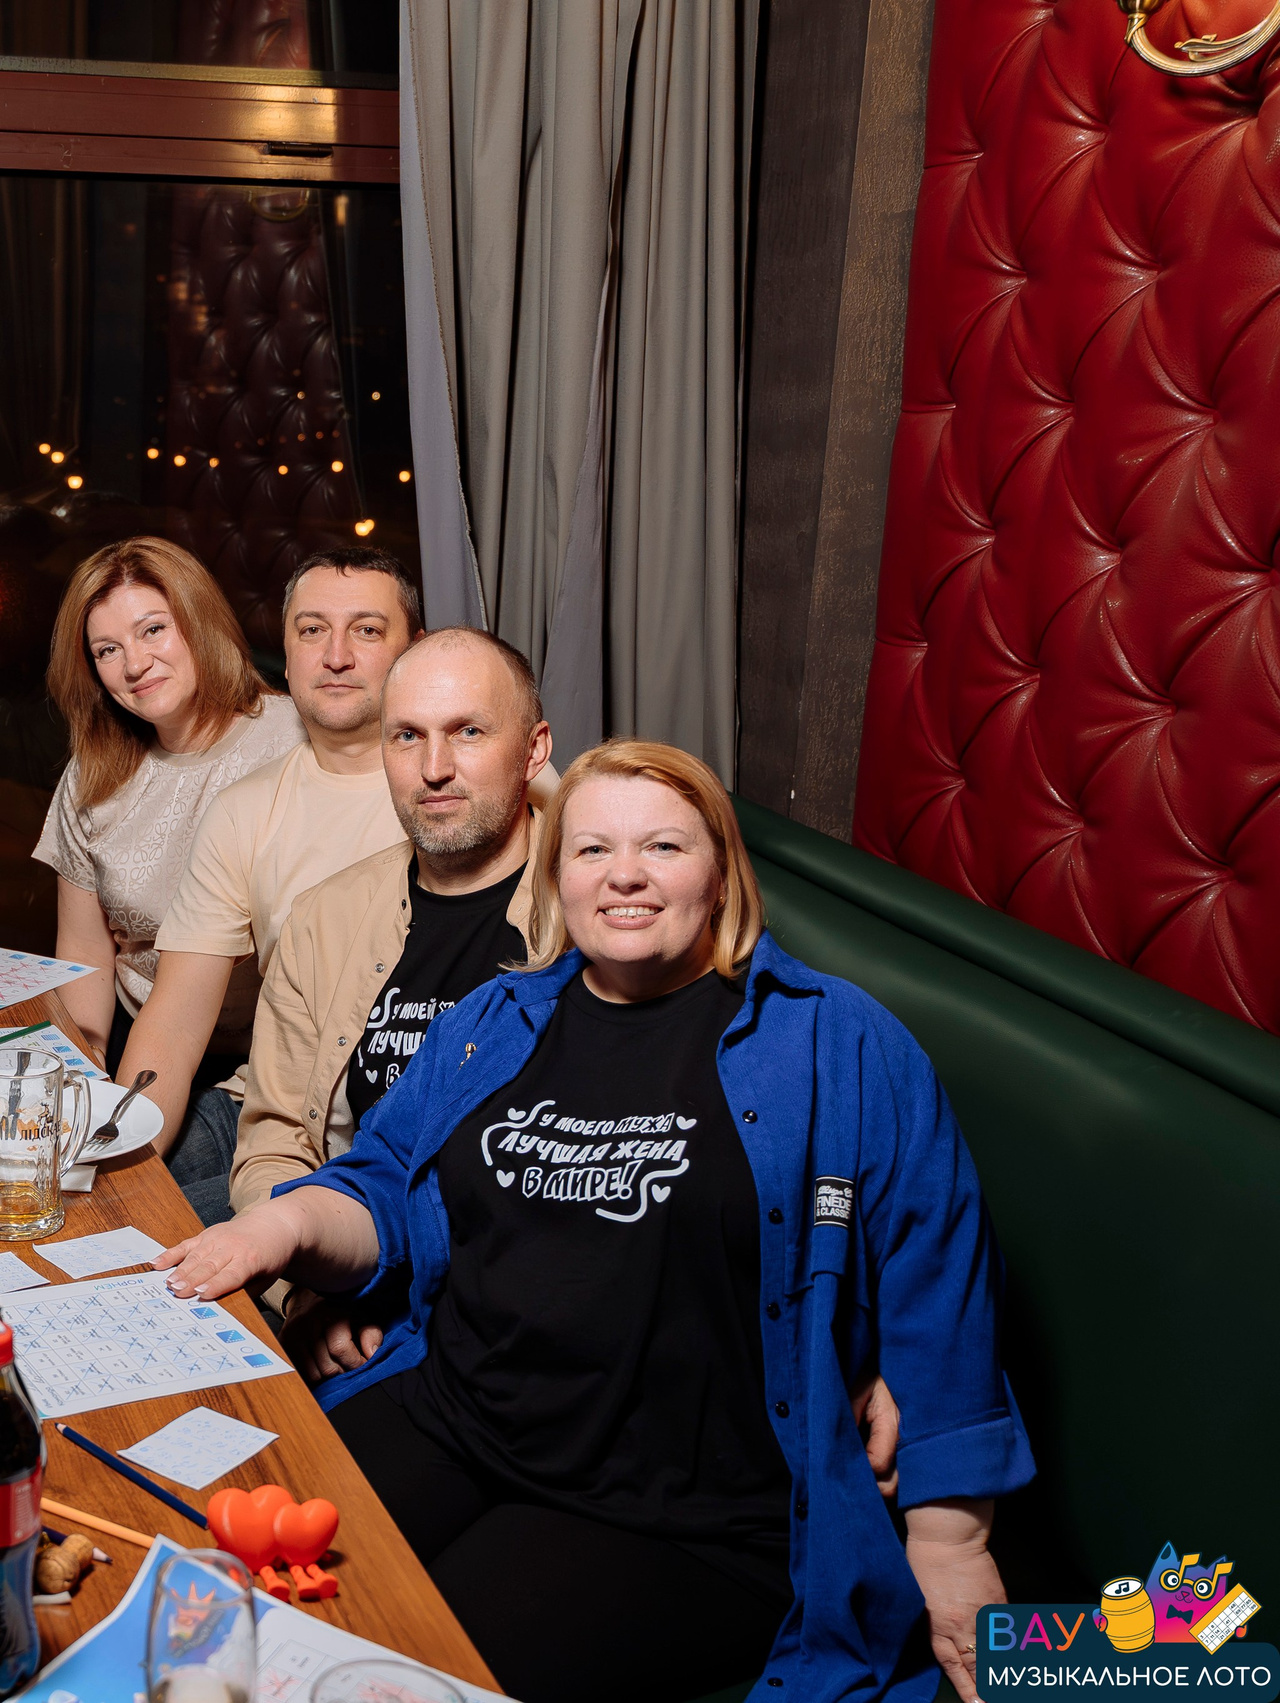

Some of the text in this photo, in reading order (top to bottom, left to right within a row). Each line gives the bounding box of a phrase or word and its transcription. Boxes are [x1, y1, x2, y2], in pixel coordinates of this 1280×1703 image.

[400, 998, 437, 1020] МОЕЙ
[367, 1030, 426, 1056] ЛУЧШ
[539, 1113, 557, 1127] У
[554, 1116, 616, 1136] МОЕГО
[498, 1131, 687, 1164] ЛУЧШАЯ ЖЕНА
[522, 1159, 645, 1201] В МИРЕ!
